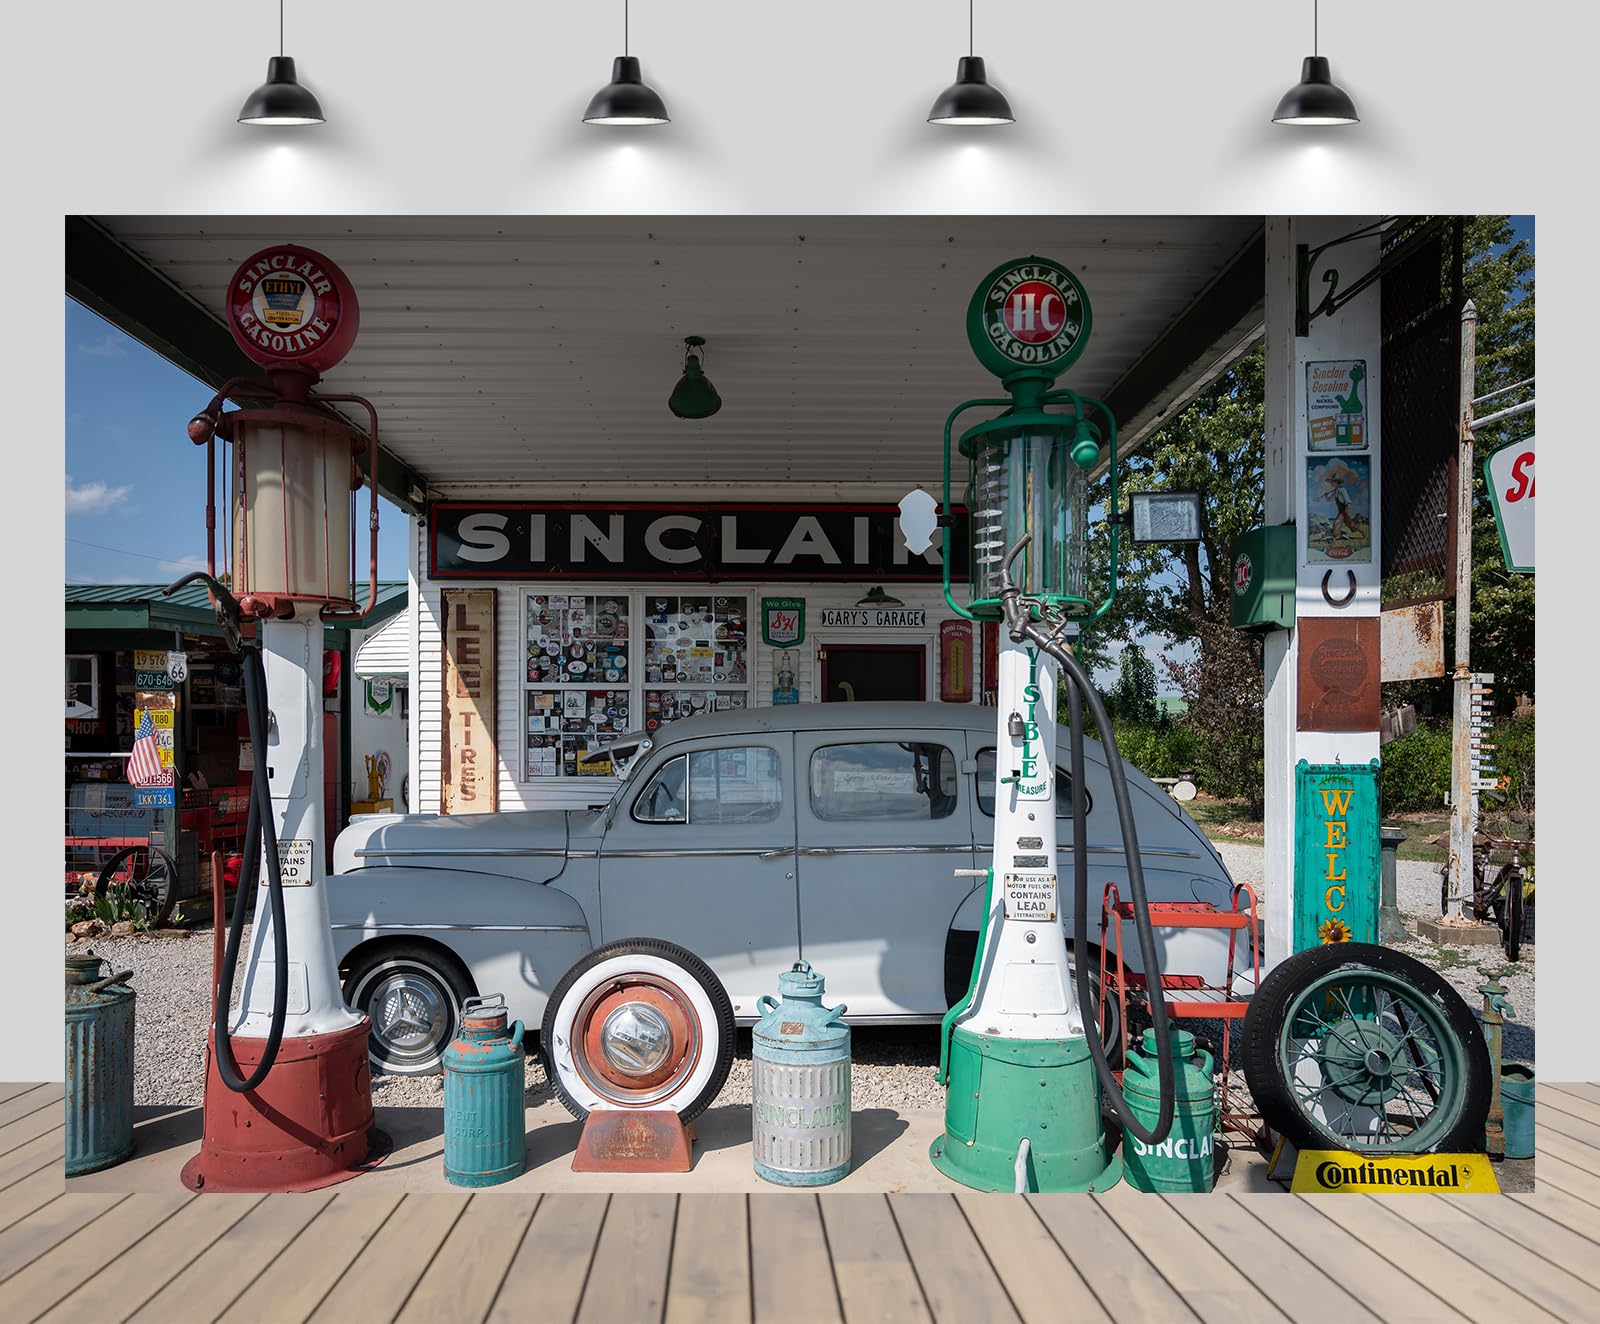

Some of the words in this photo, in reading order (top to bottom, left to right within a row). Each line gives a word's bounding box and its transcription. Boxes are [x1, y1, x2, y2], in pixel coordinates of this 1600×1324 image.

[240, 256, 332, 296] SINCLAIR
[265, 281, 304, 295] ETHYL
[990, 266, 1080, 306] SINCLAIR
[241, 312, 330, 352] GASOLINE
[989, 321, 1080, 362] GASOLINE
[1312, 367, 1347, 379] Sinclair
[1312, 381, 1349, 393] Gasoline
[1505, 451, 1535, 502] S
[766, 600, 780, 608] We
[781, 600, 801, 608] Give
[827, 611, 868, 626] GARY'S
[876, 611, 920, 626] GARAGE
[456, 604, 480, 698] LEE
[149, 655, 165, 666] 576
[171, 666, 185, 679] 66
[459, 712, 476, 801] TIRES
[1015, 781, 1047, 796] MEASURE
[280, 857, 305, 865] TAINS
[281, 867, 298, 877] AD
[1010, 891, 1052, 899] CONTAINS
[1017, 902, 1046, 911] LEAD
[1316, 1160, 1459, 1190] Continental
